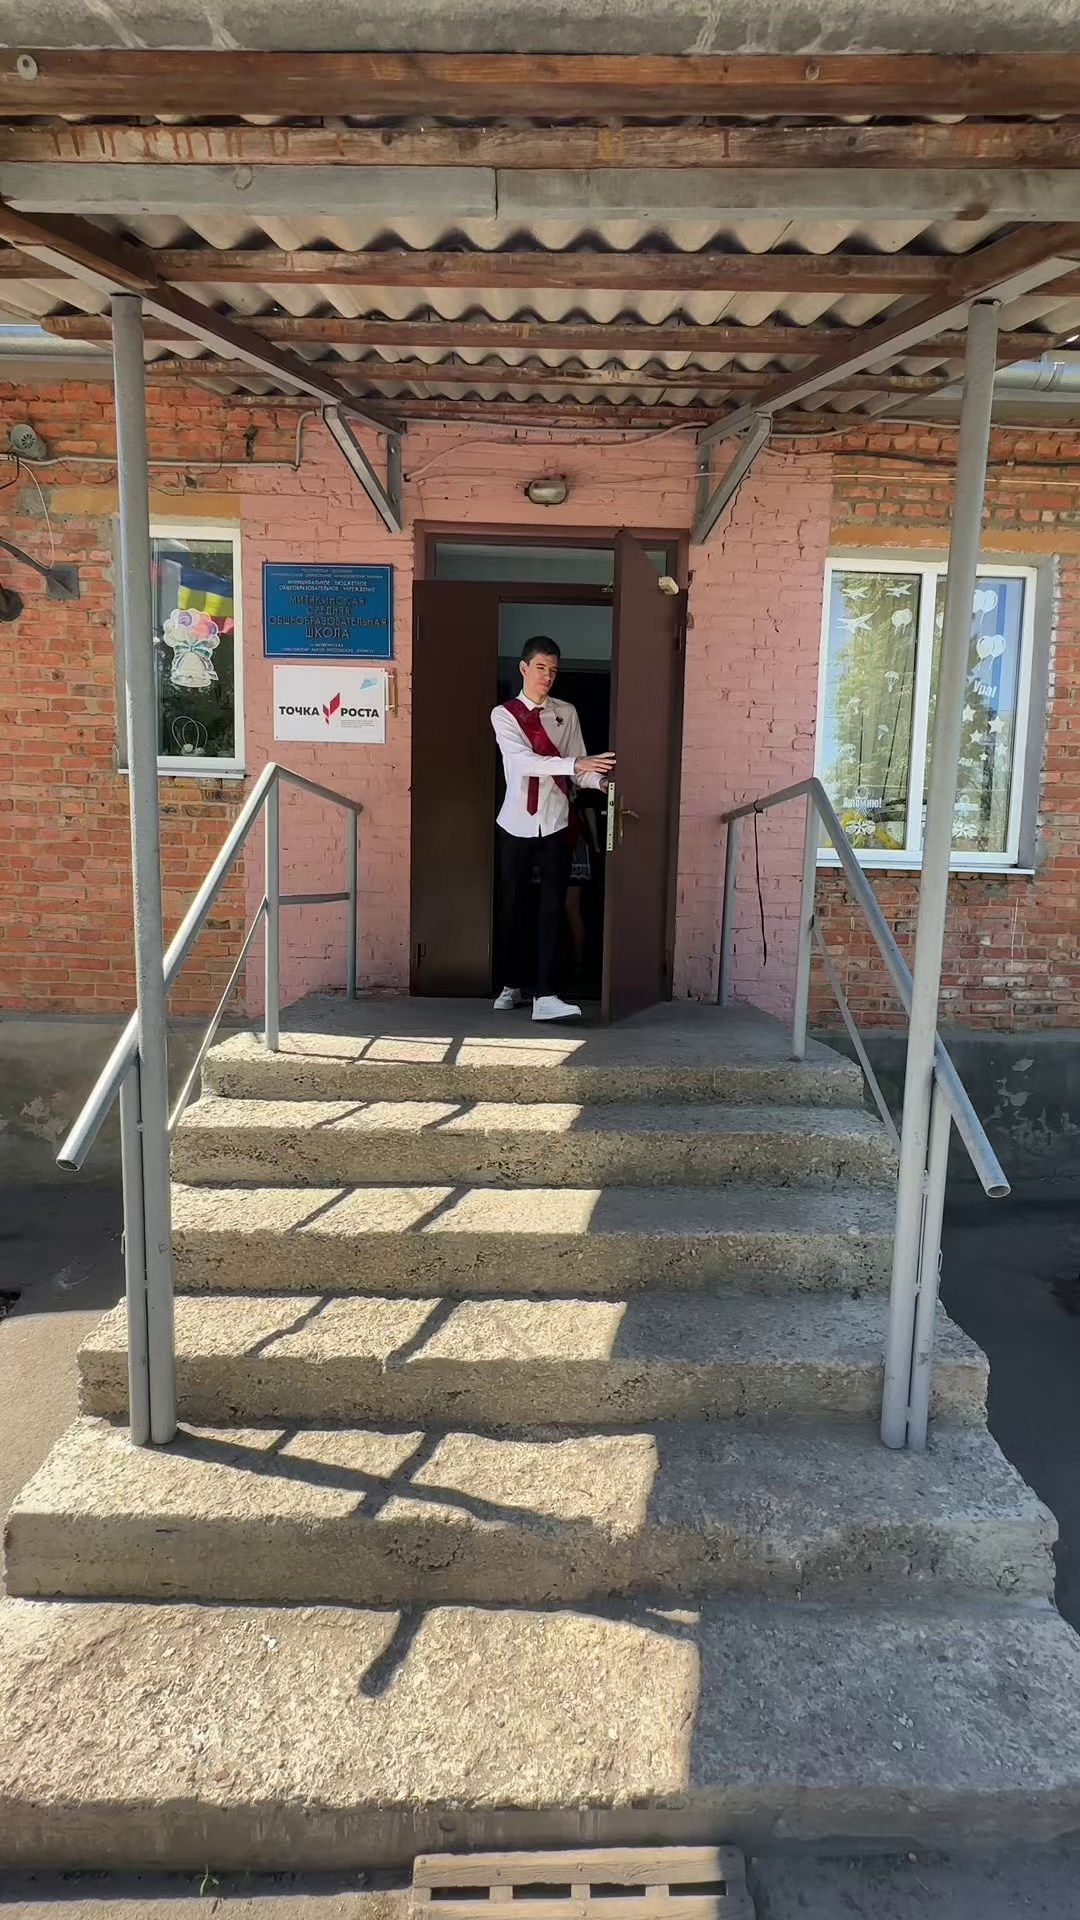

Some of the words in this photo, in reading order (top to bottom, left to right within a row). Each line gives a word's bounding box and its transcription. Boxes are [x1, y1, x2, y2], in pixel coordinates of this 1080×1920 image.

[289, 595, 366, 606] МИТЯКИНСКАЯ
[306, 606, 351, 616] СРЕДНЯЯ
[268, 616, 388, 628] ОБЩЕОБРАЗОВАТЕЛЬНАЯ
[305, 628, 350, 639] ШКОЛА
[279, 706, 320, 716] ТОЧКА
[340, 708, 380, 718] РОСТА
